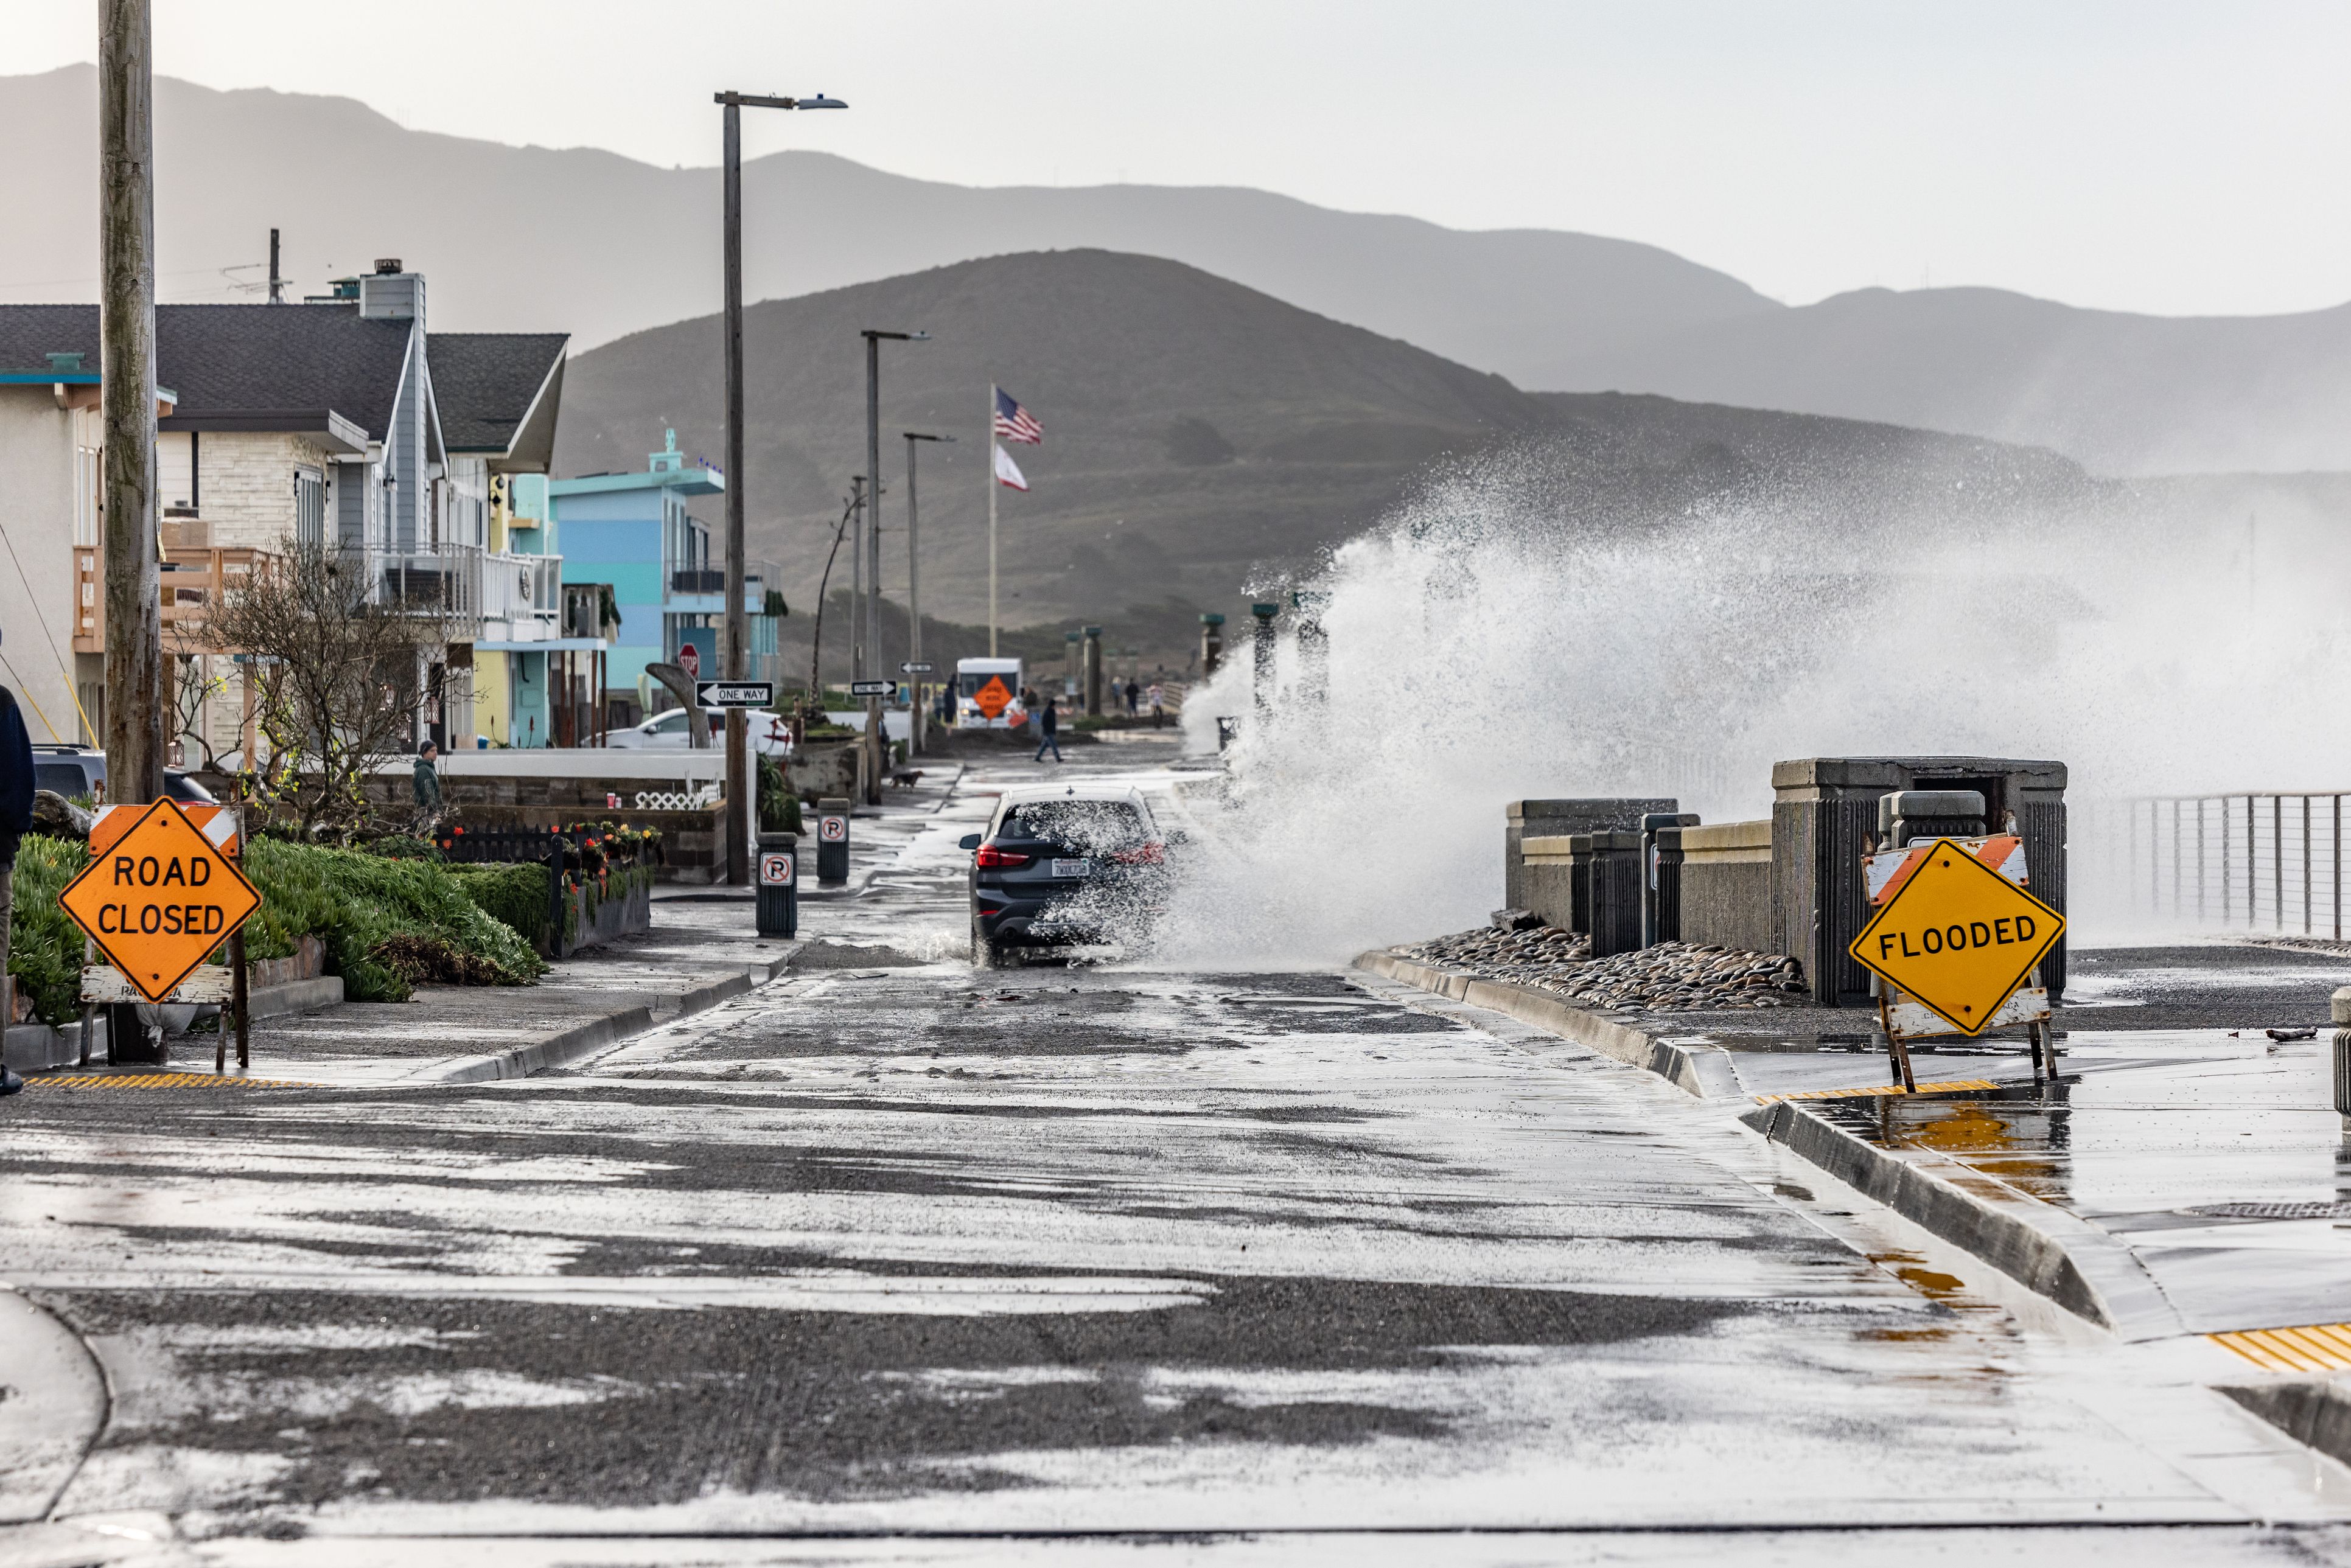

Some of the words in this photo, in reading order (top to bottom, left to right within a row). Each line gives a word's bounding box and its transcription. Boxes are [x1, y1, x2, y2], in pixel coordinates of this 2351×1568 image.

[680, 655, 697, 670] STOP
[719, 690, 739, 699] ONE
[744, 690, 764, 699] WAY
[114, 856, 211, 887] ROAD
[99, 904, 225, 935] CLOSED
[1879, 915, 2036, 960] FLOODED
